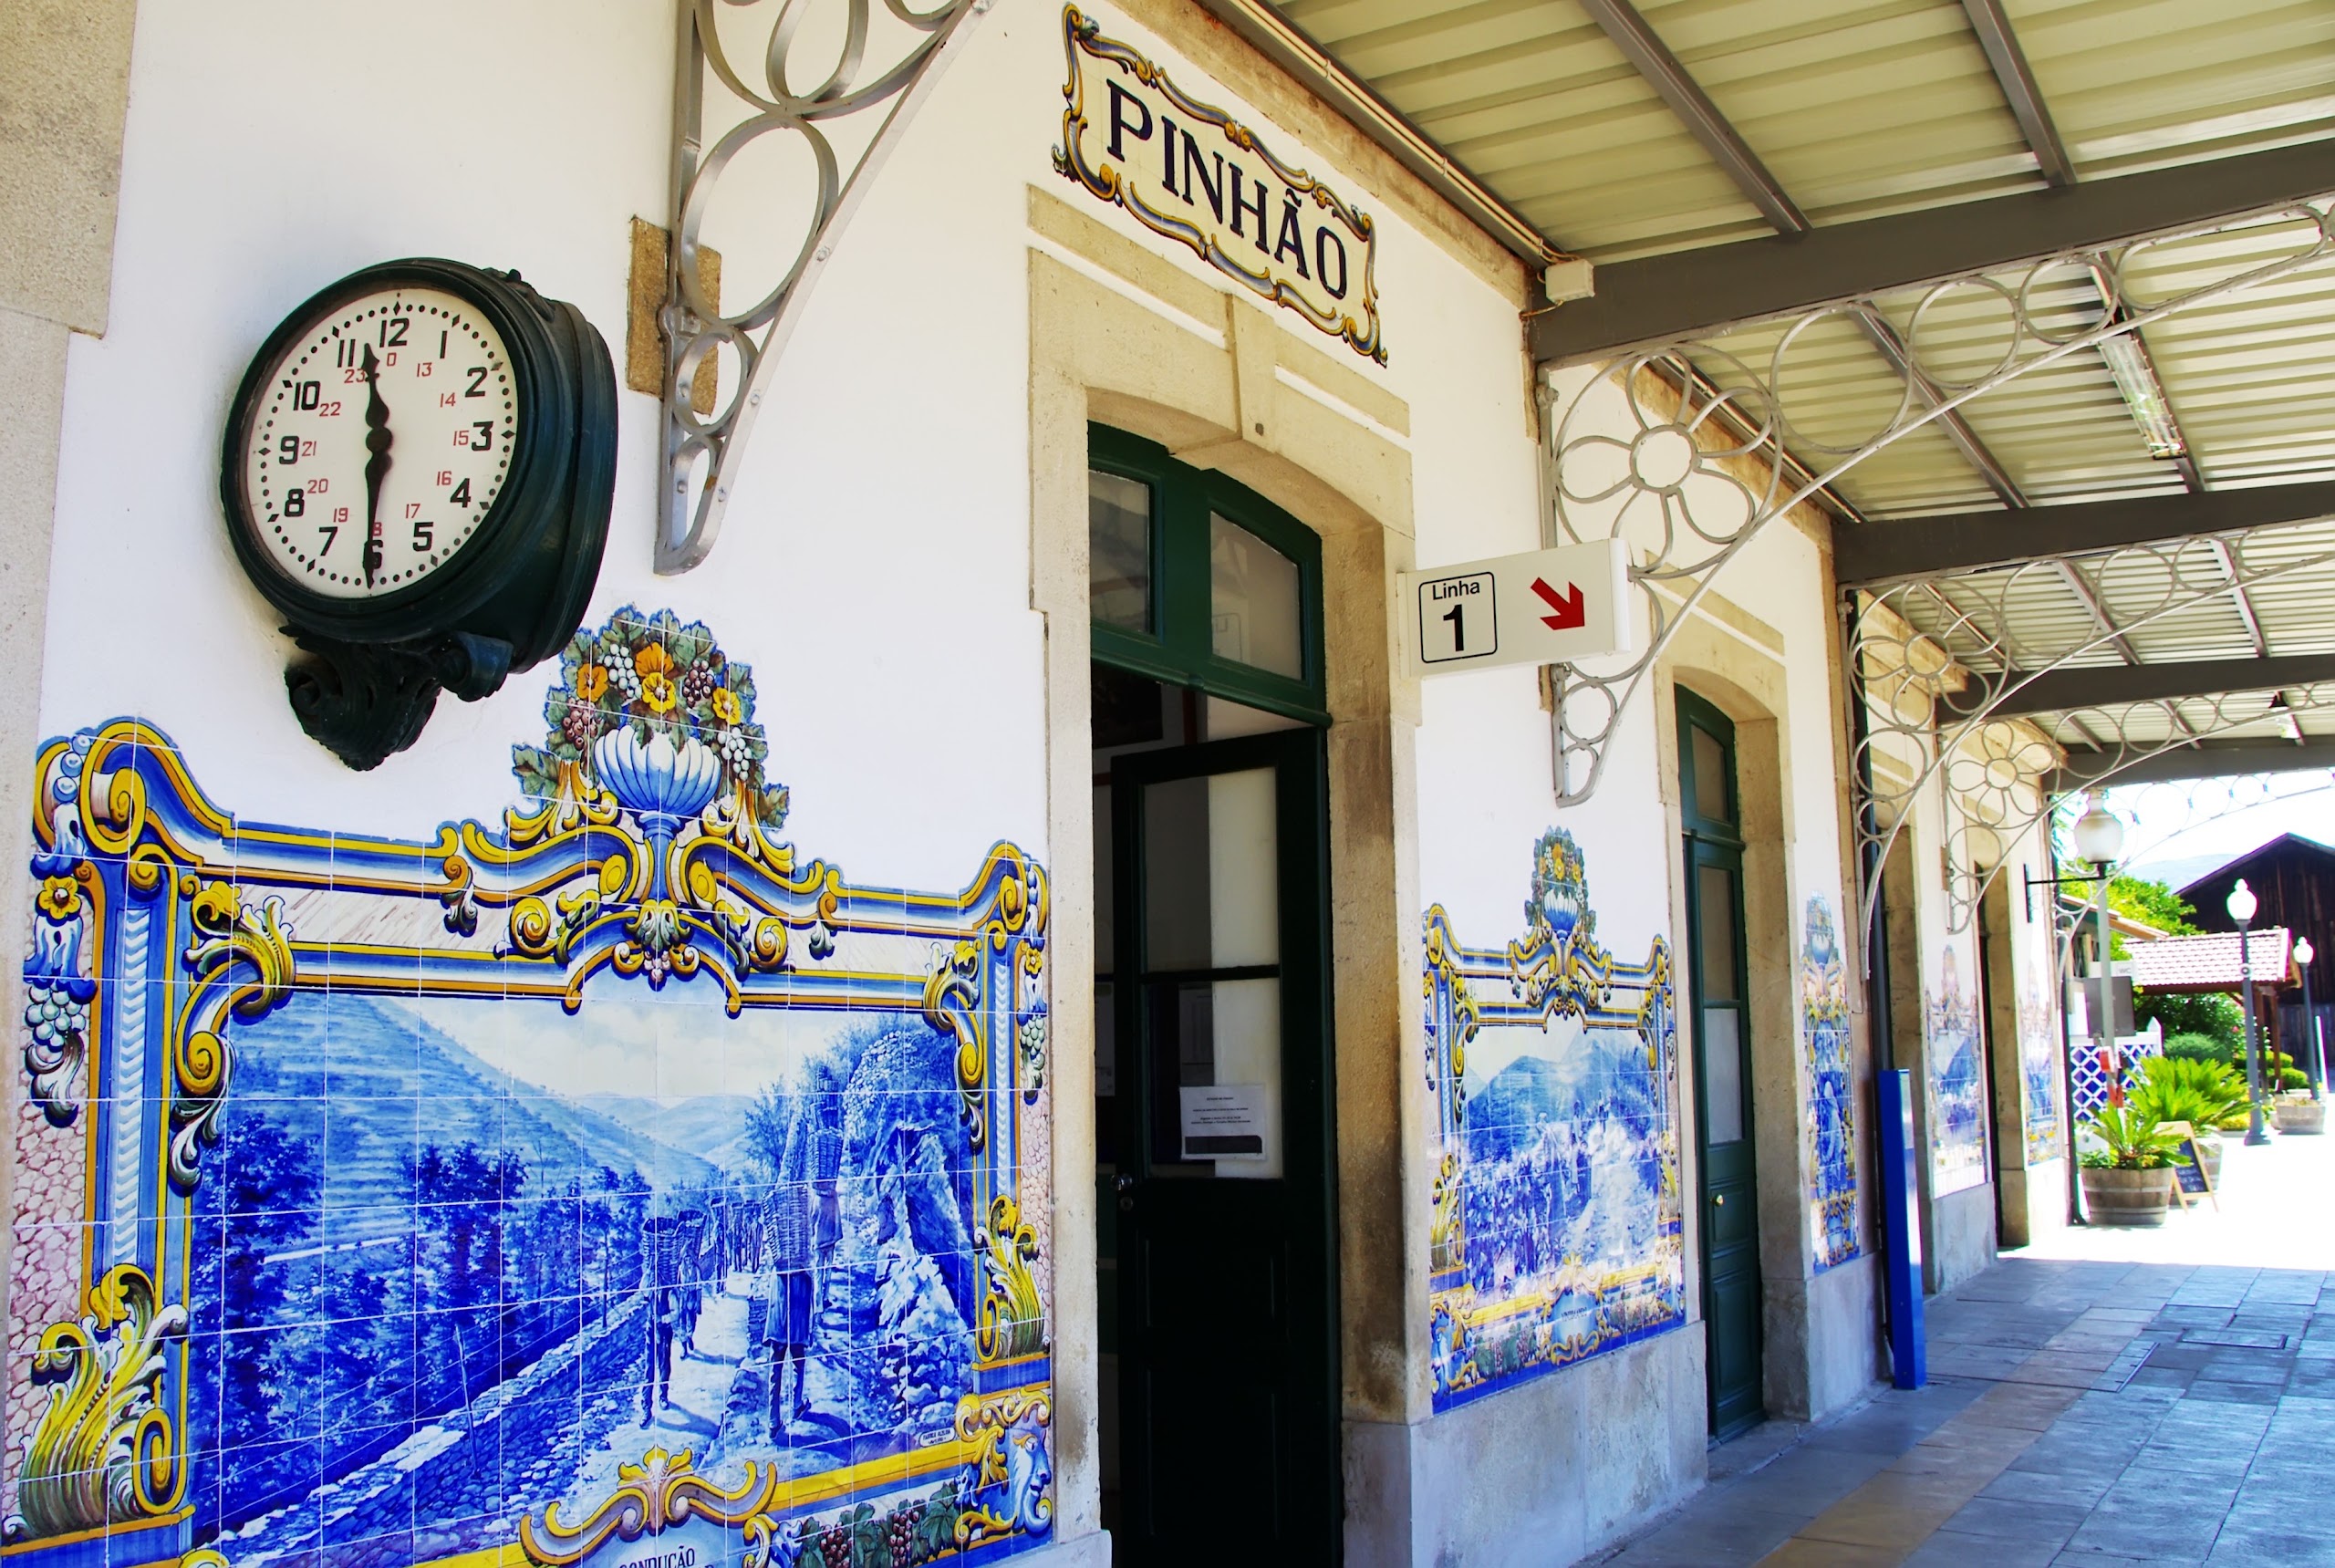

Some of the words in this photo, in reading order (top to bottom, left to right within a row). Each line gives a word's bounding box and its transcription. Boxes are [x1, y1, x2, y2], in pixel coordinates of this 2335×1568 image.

[1106, 78, 1348, 300] PINHÃO
[379, 317, 410, 348] 12
[440, 330, 448, 359] 1
[337, 338, 357, 369] 11
[386, 352, 397, 367] 0
[344, 368, 367, 384] 23
[417, 362, 432, 378] 13
[465, 367, 488, 397] 2
[293, 380, 321, 410] 10
[319, 402, 341, 417] 22
[440, 392, 456, 408] 14
[279, 435, 300, 464] 9
[301, 441, 317, 457] 21
[453, 431, 469, 446] 15
[471, 421, 493, 451] 3
[307, 479, 328, 493] 20
[436, 471, 451, 486] 16
[450, 478, 472, 508] 4
[285, 488, 305, 517] 8
[333, 507, 348, 523] 19
[405, 504, 420, 519] 17
[318, 526, 337, 556] 7
[413, 522, 434, 552] 5
[363, 539, 383, 570] 6
[1432, 580, 1480, 600] Linha
[1443, 604, 1464, 652] 1
[619, 1545, 695, 1568] NDUÇÃO
